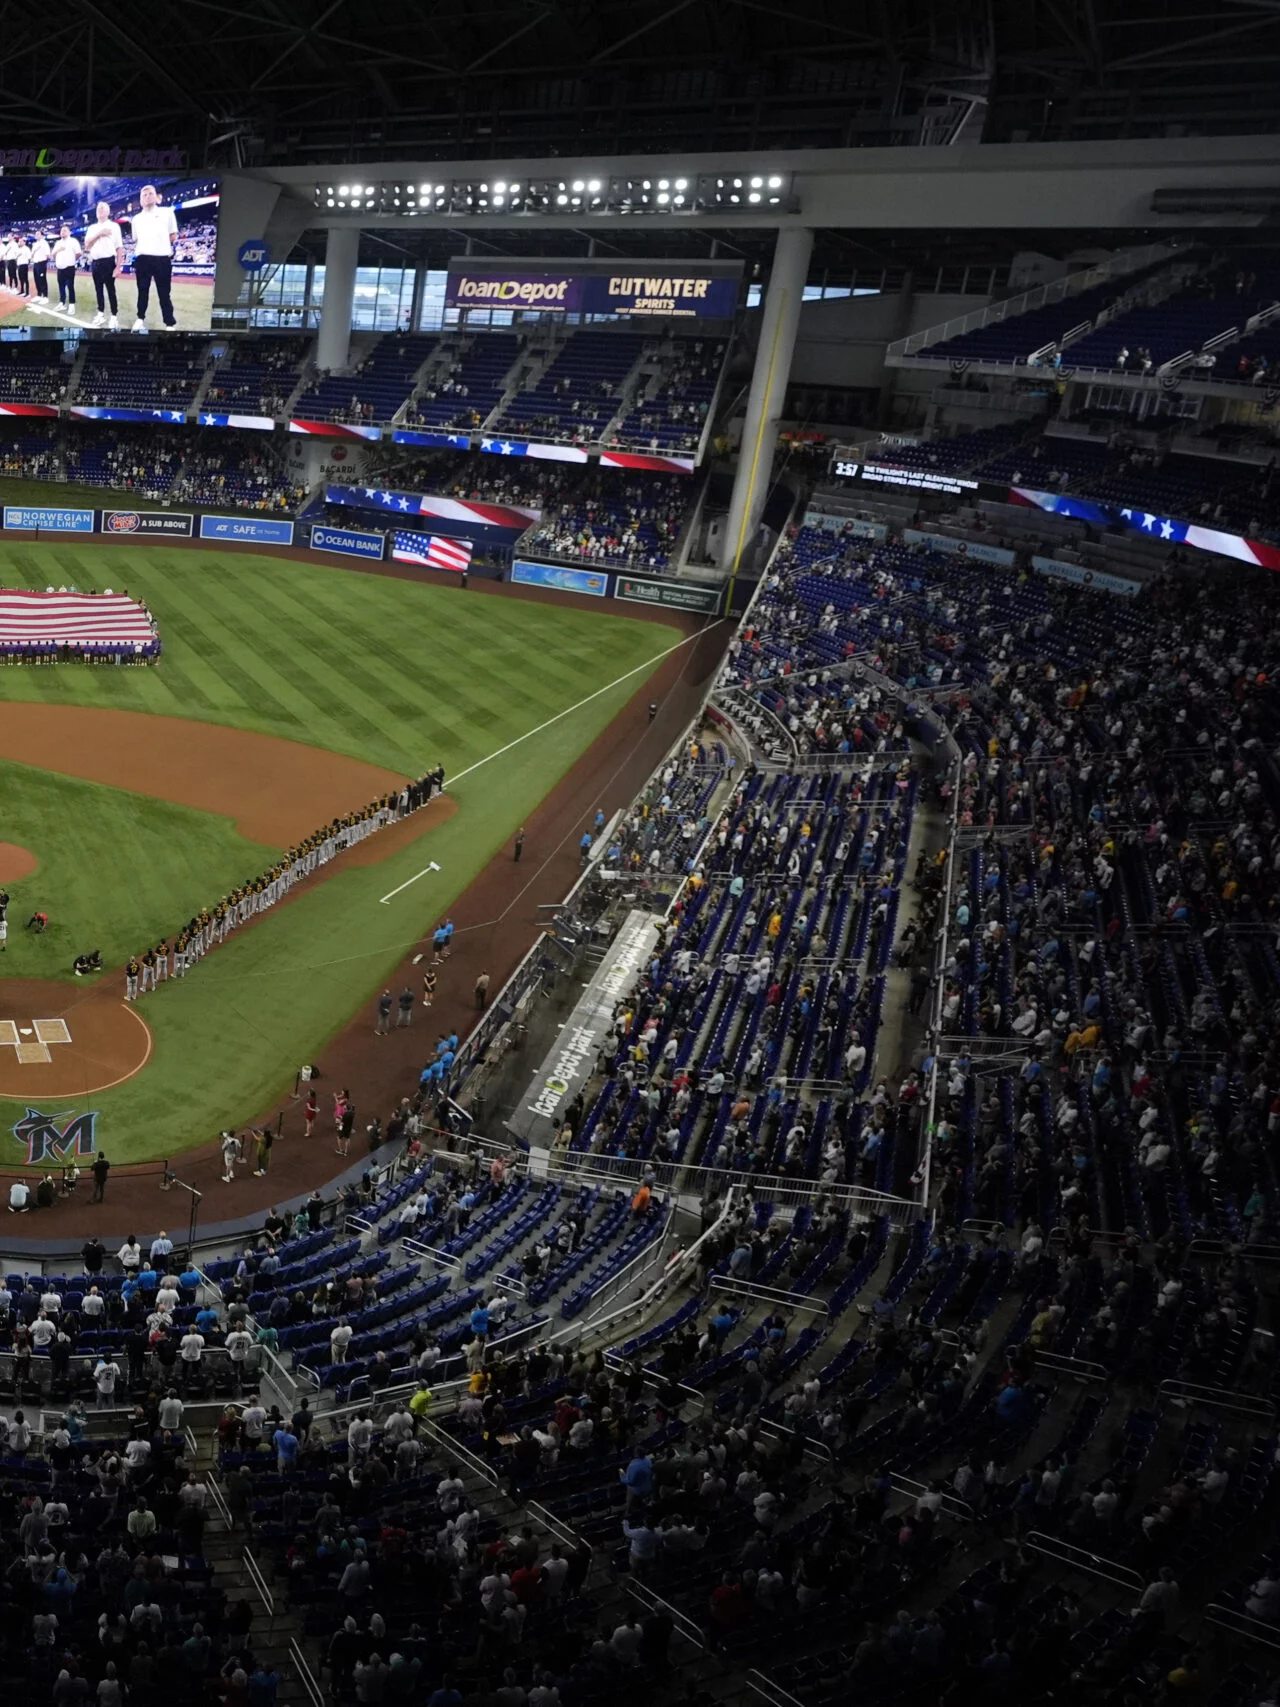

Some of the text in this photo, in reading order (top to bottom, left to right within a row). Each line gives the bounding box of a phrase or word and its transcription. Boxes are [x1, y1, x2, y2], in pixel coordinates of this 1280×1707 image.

[241, 250, 265, 262] ADT
[458, 278, 569, 303] loanDepot
[608, 278, 708, 298] CUTWATER
[634, 299, 675, 309] SPIRITS
[23, 511, 90, 523] NORWEGIAN
[23, 520, 77, 528] CRUISE LINE
[148, 520, 162, 528] SUB
[163, 521, 187, 530] ABOVE
[216, 524, 228, 532] ADT
[233, 525, 257, 535] SAFE
[326, 535, 381, 552] OCEAN BANK
[528, 1027, 597, 1118] loanDepot park
